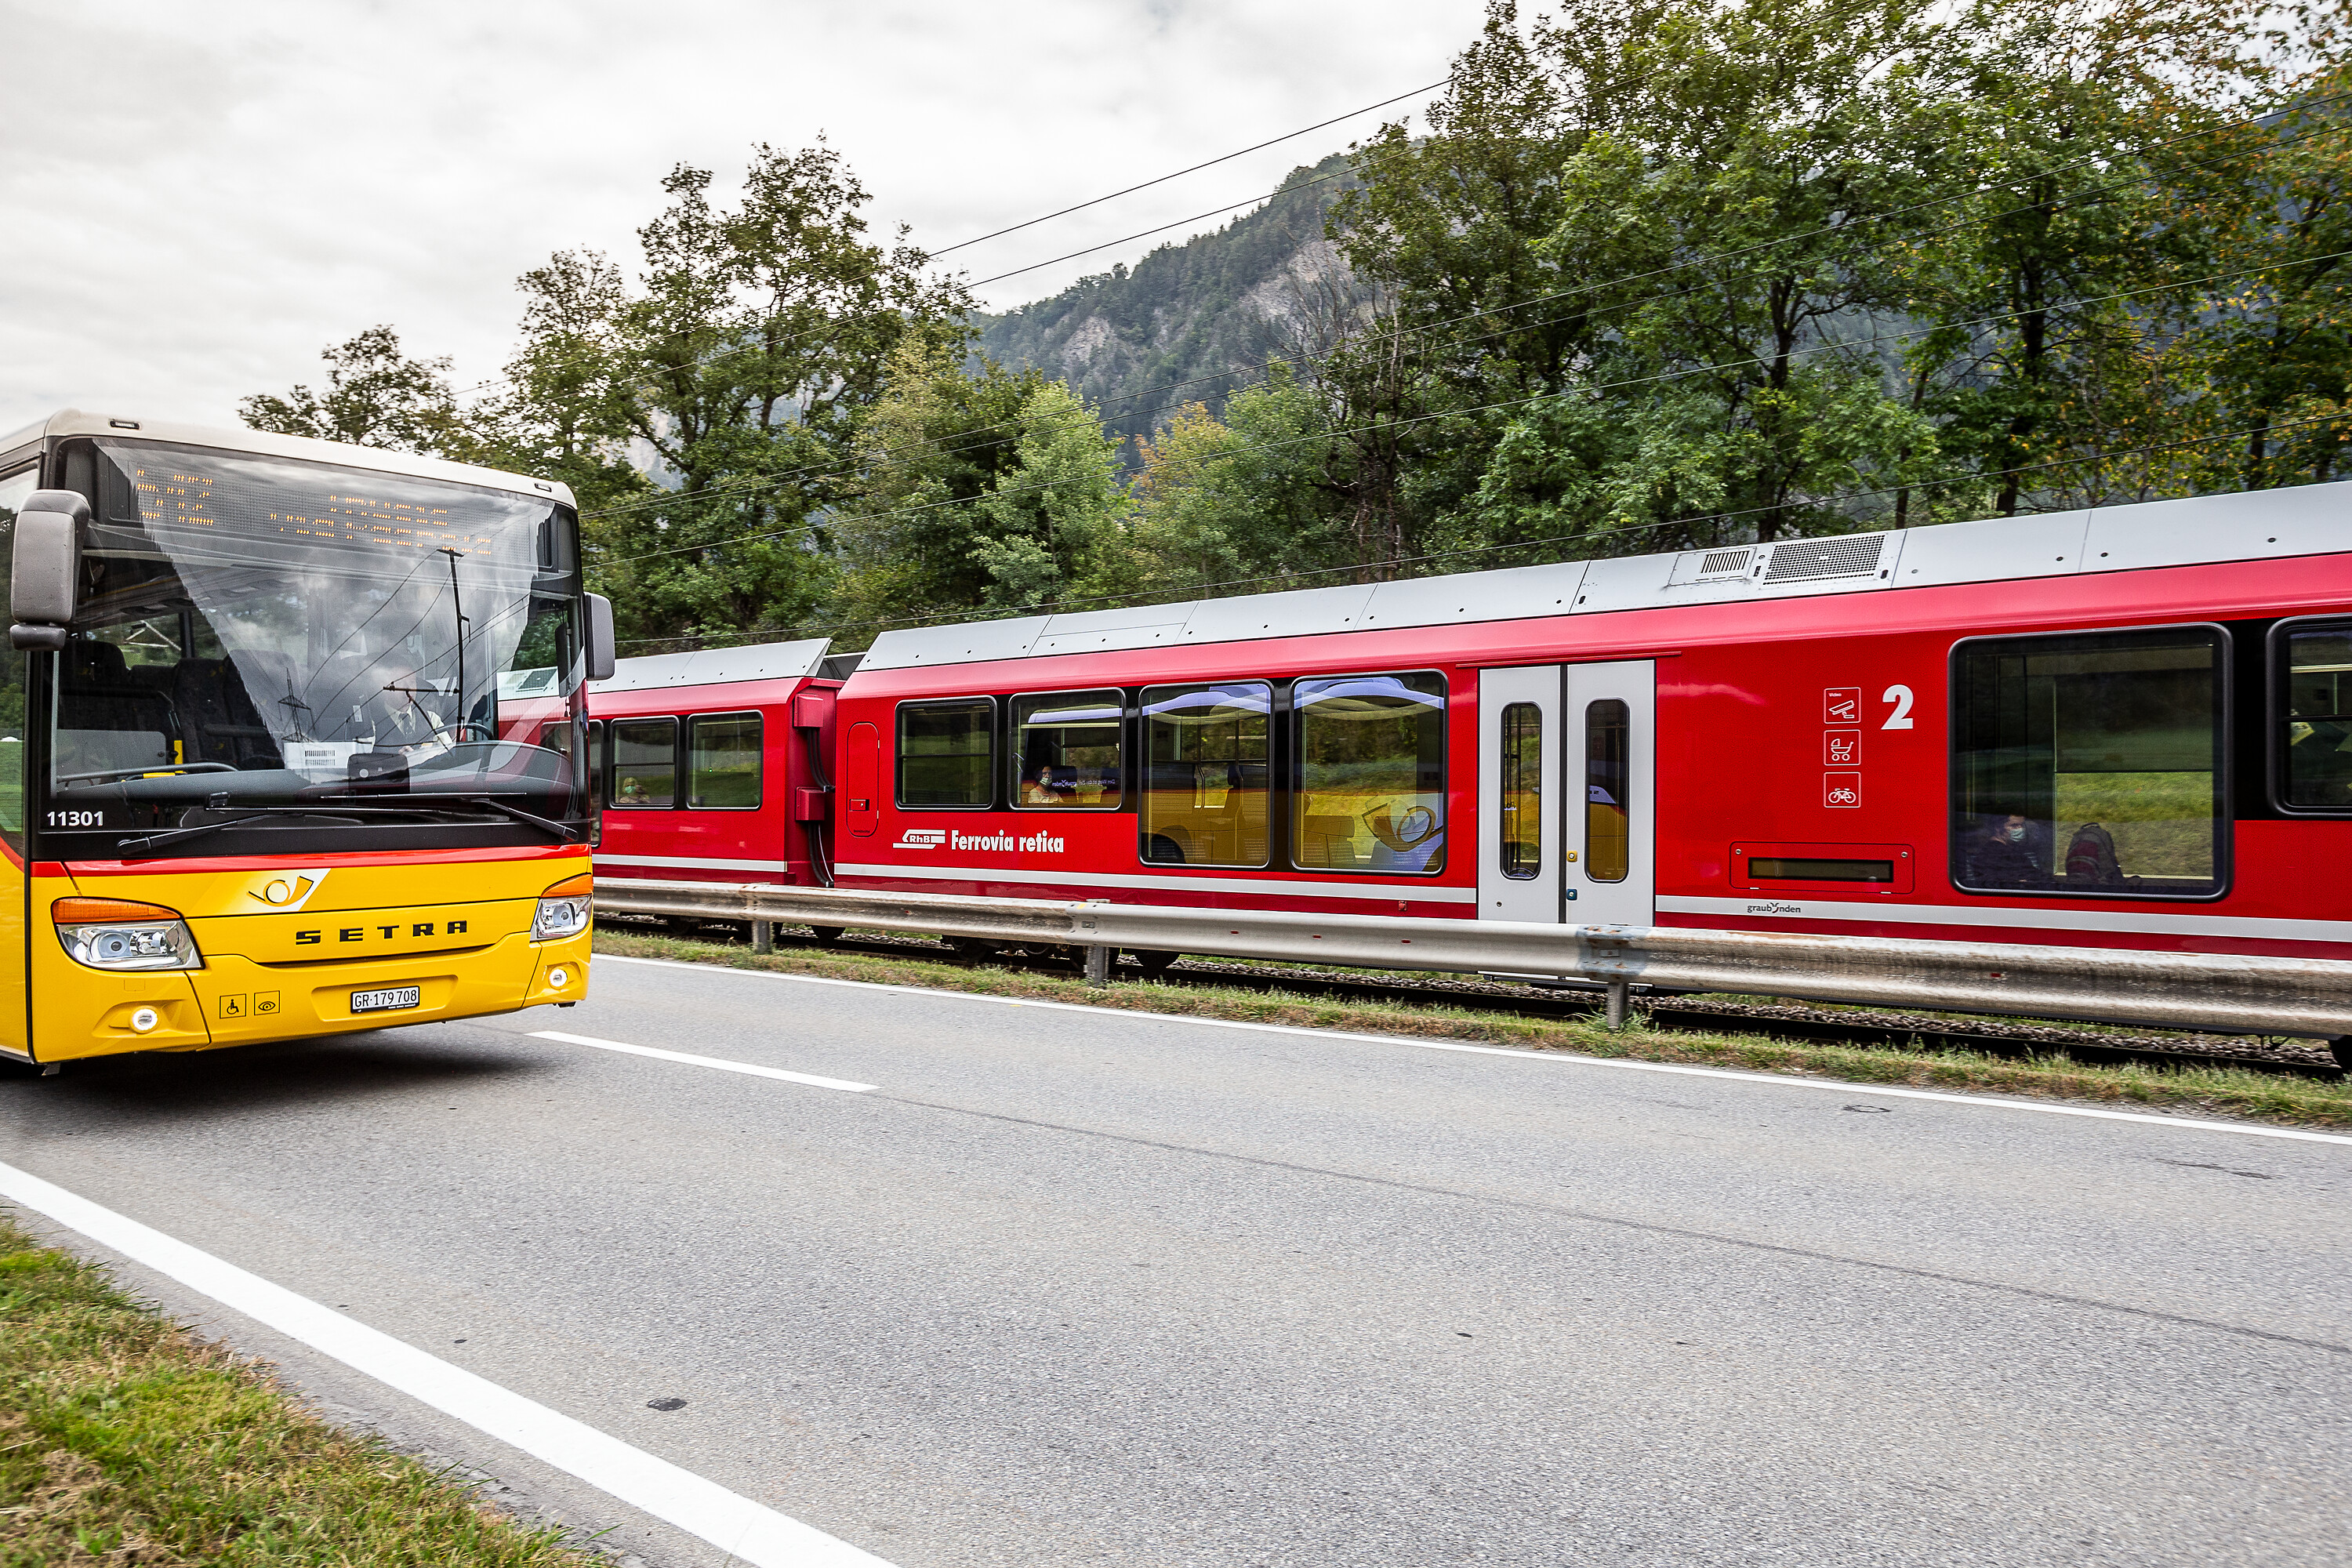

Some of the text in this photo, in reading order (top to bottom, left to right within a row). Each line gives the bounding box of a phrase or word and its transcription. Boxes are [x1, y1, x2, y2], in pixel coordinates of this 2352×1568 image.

[1881, 684, 1914, 730] 2
[47, 811, 103, 826] 11301
[909, 835, 931, 844] RhB
[951, 829, 1064, 853] Ferrovia retica
[296, 920, 467, 945] SETRA
